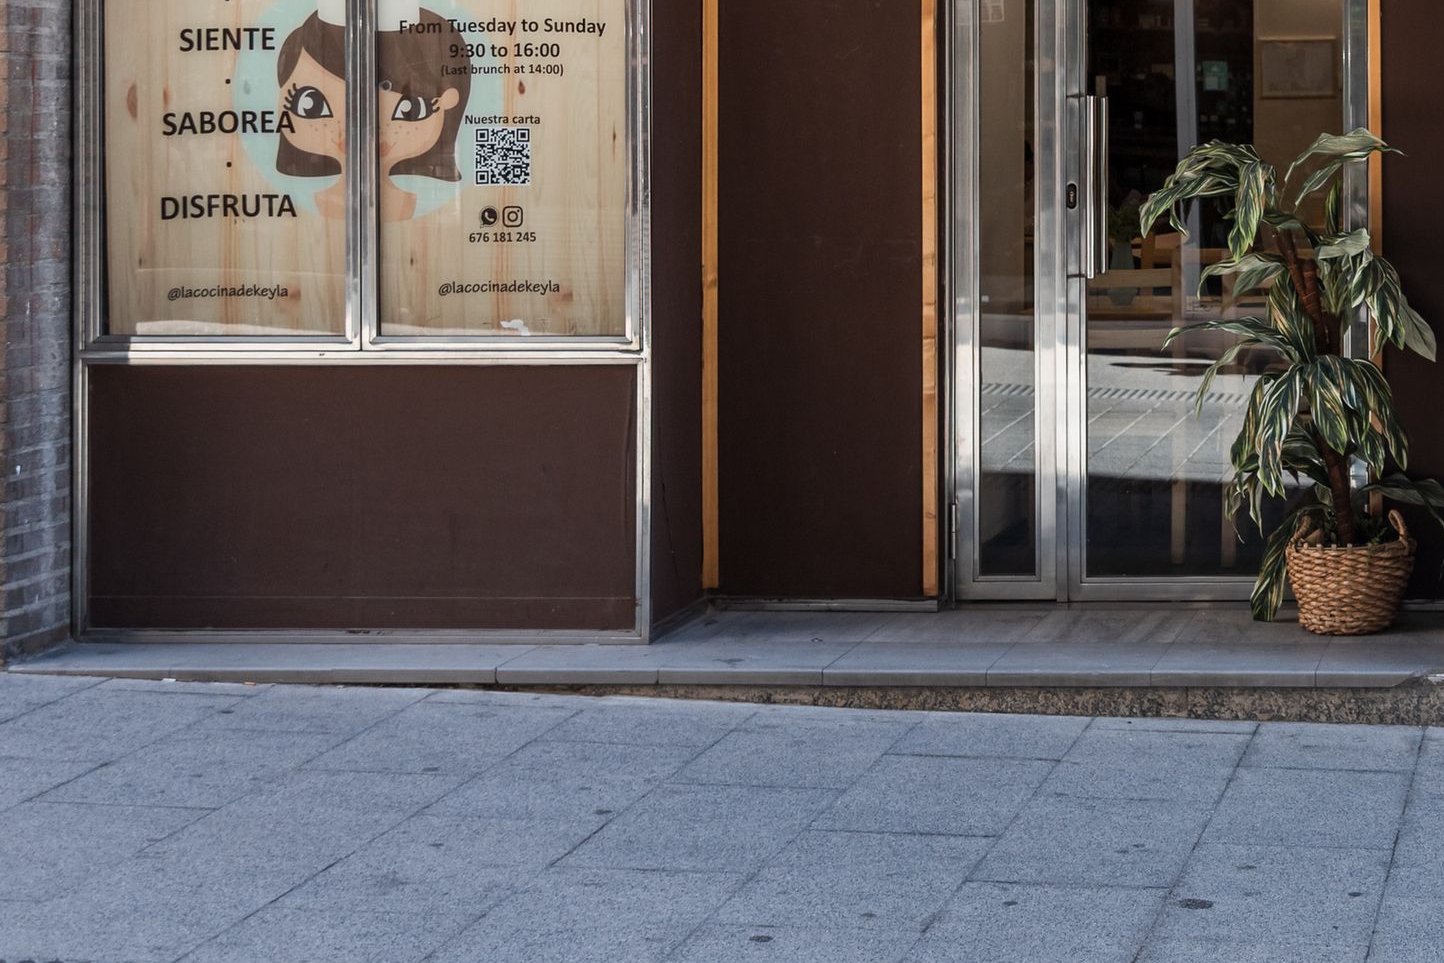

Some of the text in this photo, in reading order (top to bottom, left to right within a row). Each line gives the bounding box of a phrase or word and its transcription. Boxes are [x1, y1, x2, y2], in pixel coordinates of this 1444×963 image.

[399, 18, 606, 37] From Tuesday to Sunday
[179, 27, 276, 52] SIENTE
[449, 43, 560, 58] 9:30 to 16:00
[441, 64, 564, 76] (Last brunch at 14:00)
[162, 110, 296, 136] SABOREA
[464, 115, 541, 125] Nuestra carta
[160, 193, 298, 220] DISFRUTA
[469, 232, 536, 243] 676 181 245
[168, 284, 289, 301] @lacocinadekeyla
[438, 280, 560, 296] @lacocinadekeyla
